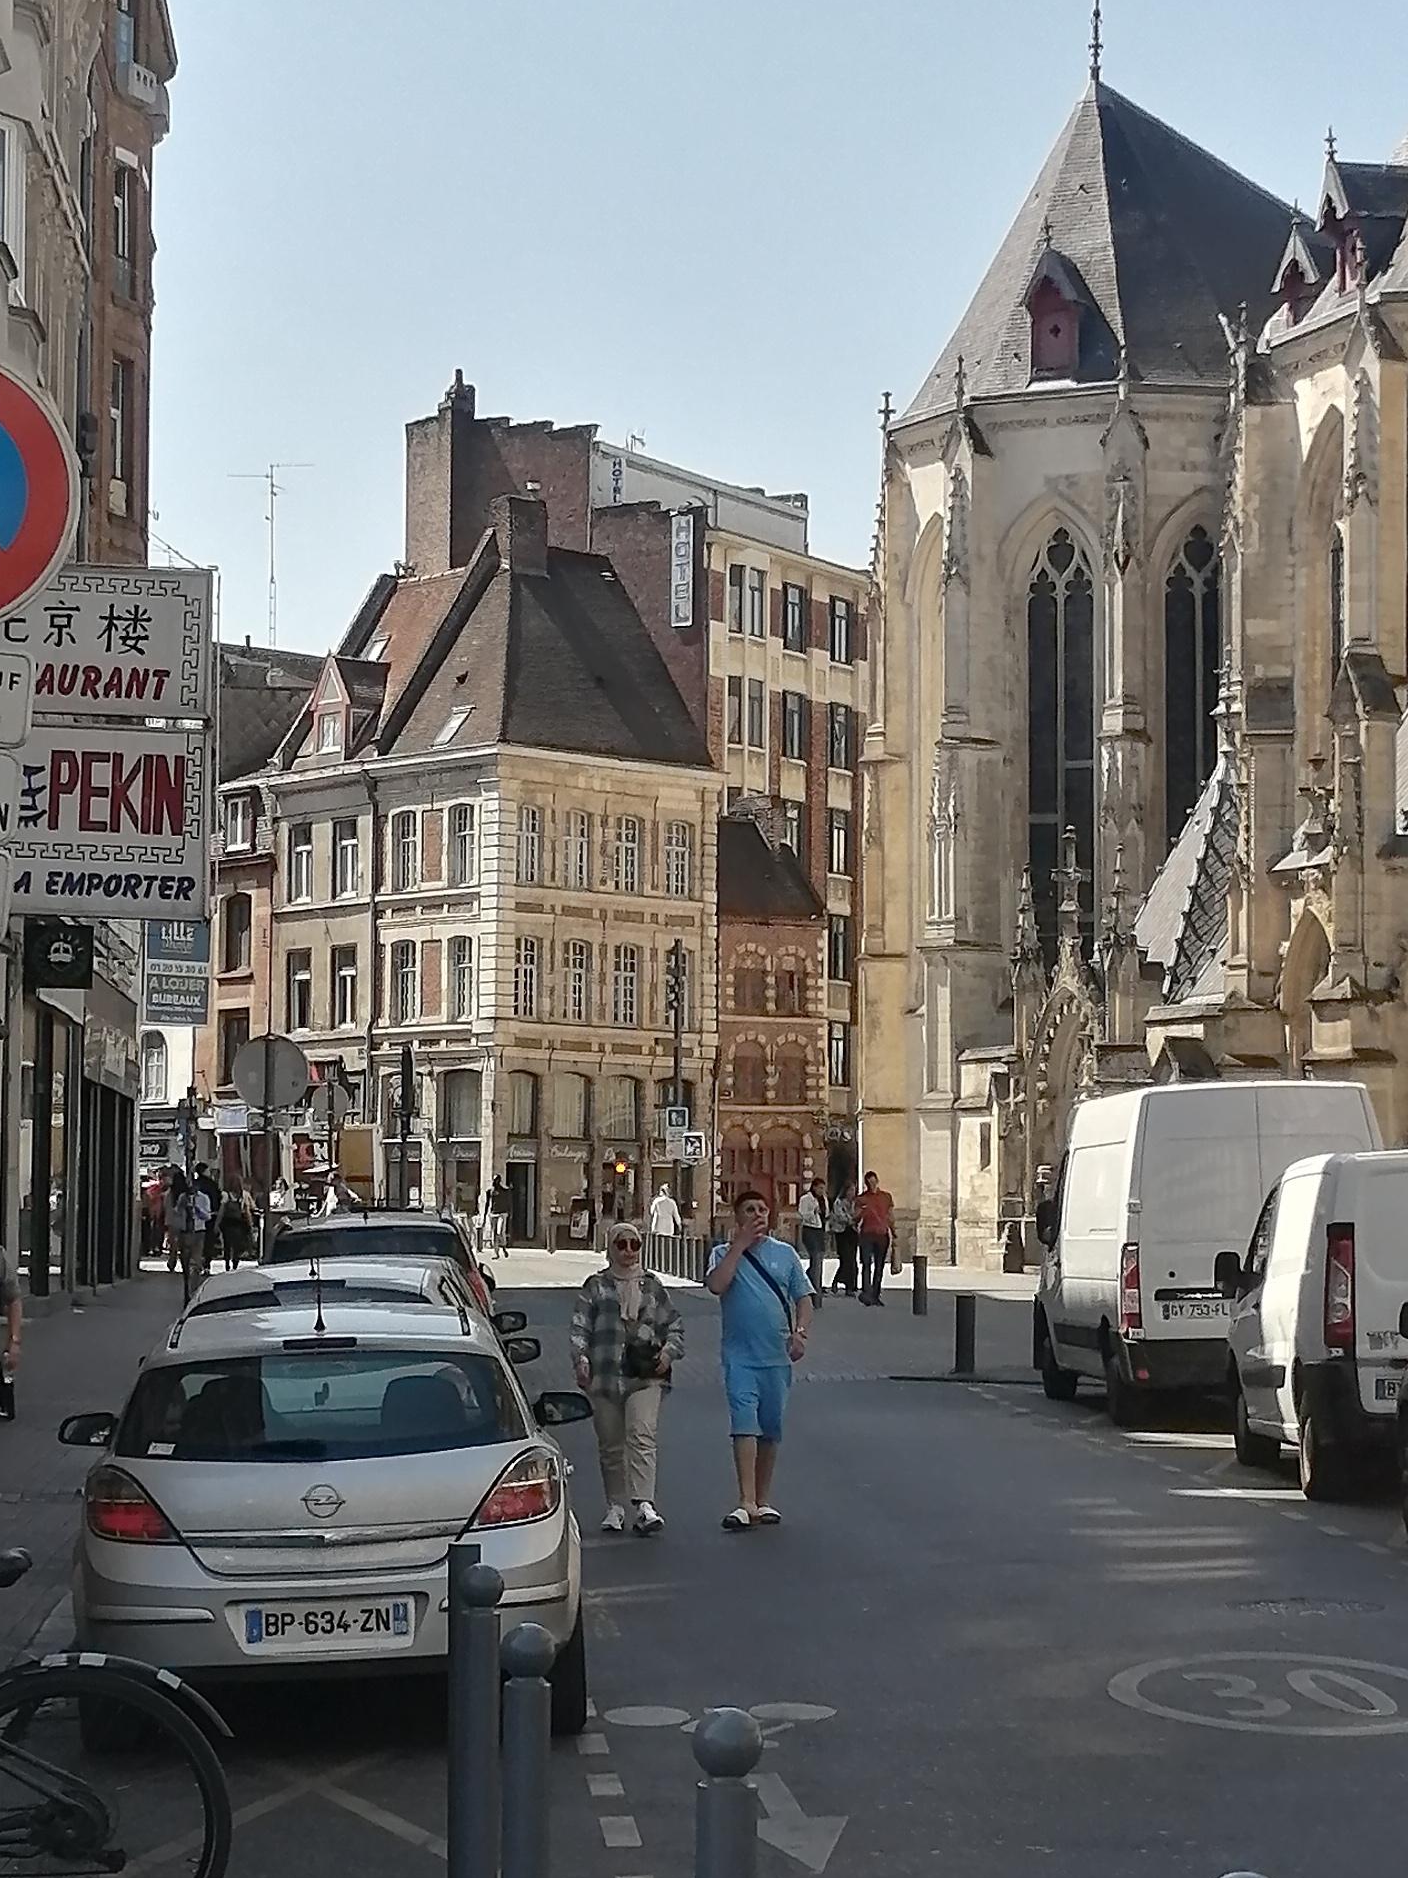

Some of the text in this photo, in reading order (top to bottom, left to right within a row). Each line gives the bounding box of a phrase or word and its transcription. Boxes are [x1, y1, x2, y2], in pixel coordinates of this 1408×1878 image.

[673, 518, 691, 623] HOTEL
[35, 662, 171, 701] AURANT
[47, 749, 186, 837] PEKIN
[45, 871, 196, 901] EMPORTER
[152, 993, 201, 1006] BUREAUX
[163, 977, 205, 991] LOUER
[264, 1607, 392, 1637] BP-634-ZN
[1182, 1669, 1398, 1717] 30
